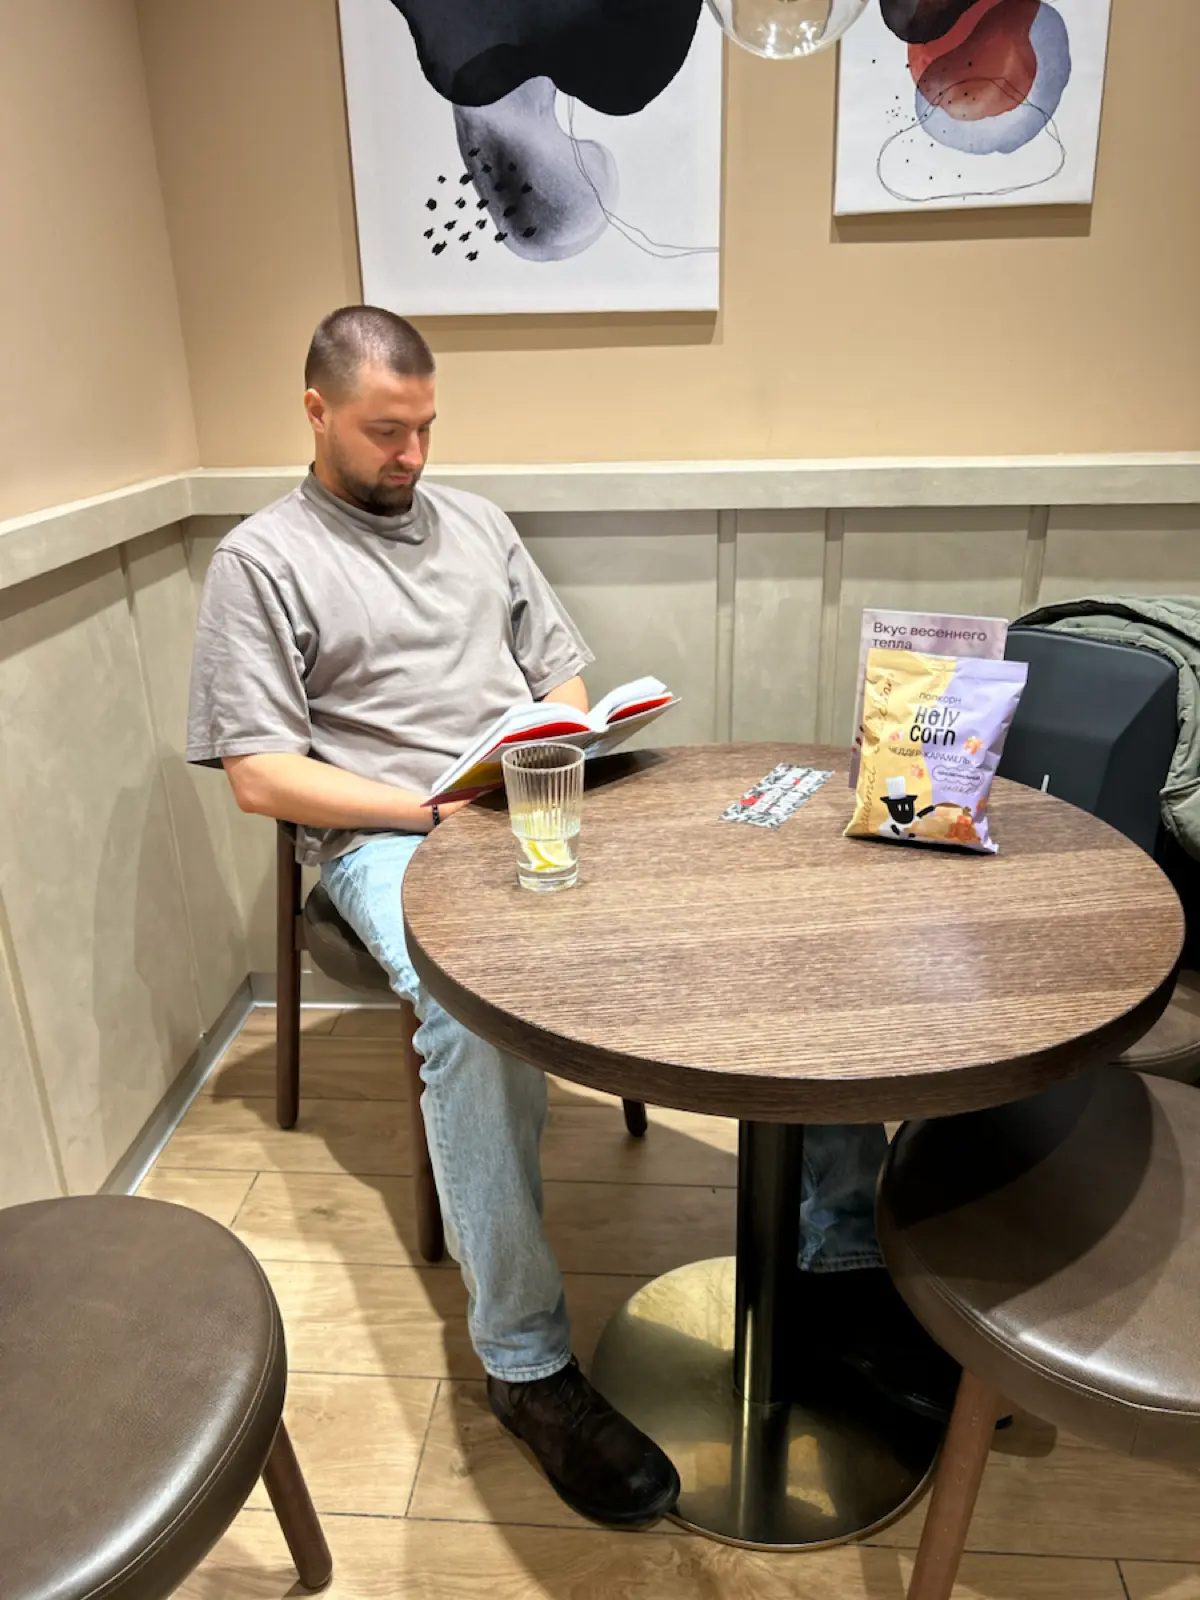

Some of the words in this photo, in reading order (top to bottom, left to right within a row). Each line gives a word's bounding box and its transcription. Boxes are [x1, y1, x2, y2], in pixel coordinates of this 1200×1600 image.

[873, 622, 906, 637] Вкус
[910, 627, 988, 642] весеннего
[872, 638, 913, 650] тепла
